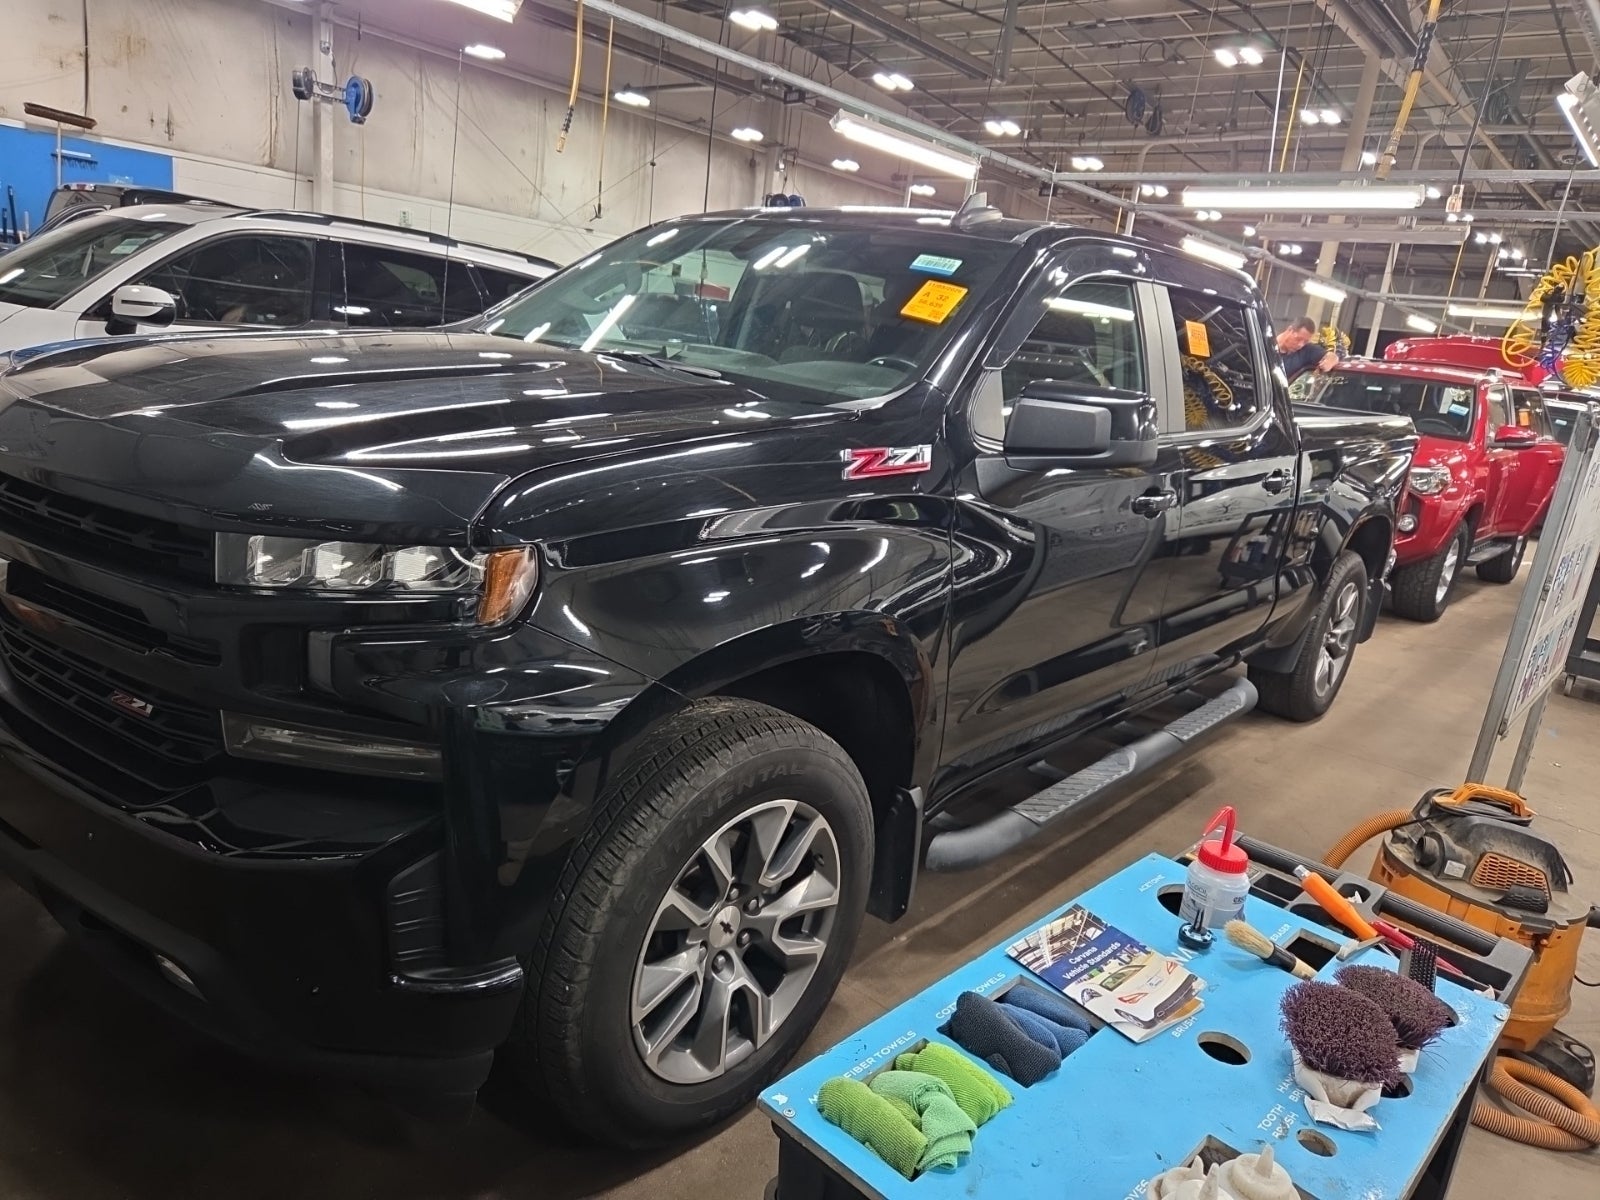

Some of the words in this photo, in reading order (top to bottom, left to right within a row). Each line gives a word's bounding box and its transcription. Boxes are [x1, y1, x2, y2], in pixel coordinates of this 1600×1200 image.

[842, 444, 932, 481] Z71
[620, 764, 806, 938] ONTINENTAL
[1062, 962, 1090, 981] Vehicle
[1087, 941, 1122, 970] Standards
[1068, 946, 1099, 965] Carvana
[936, 1001, 957, 1020] COT
[974, 972, 1006, 994] OWELS
[1171, 1016, 1198, 1038] BRUSH
[875, 1029, 918, 1060] TOWELS
[1276, 1073, 1295, 1094] HAN
[1257, 1103, 1286, 1132] TOOTH
